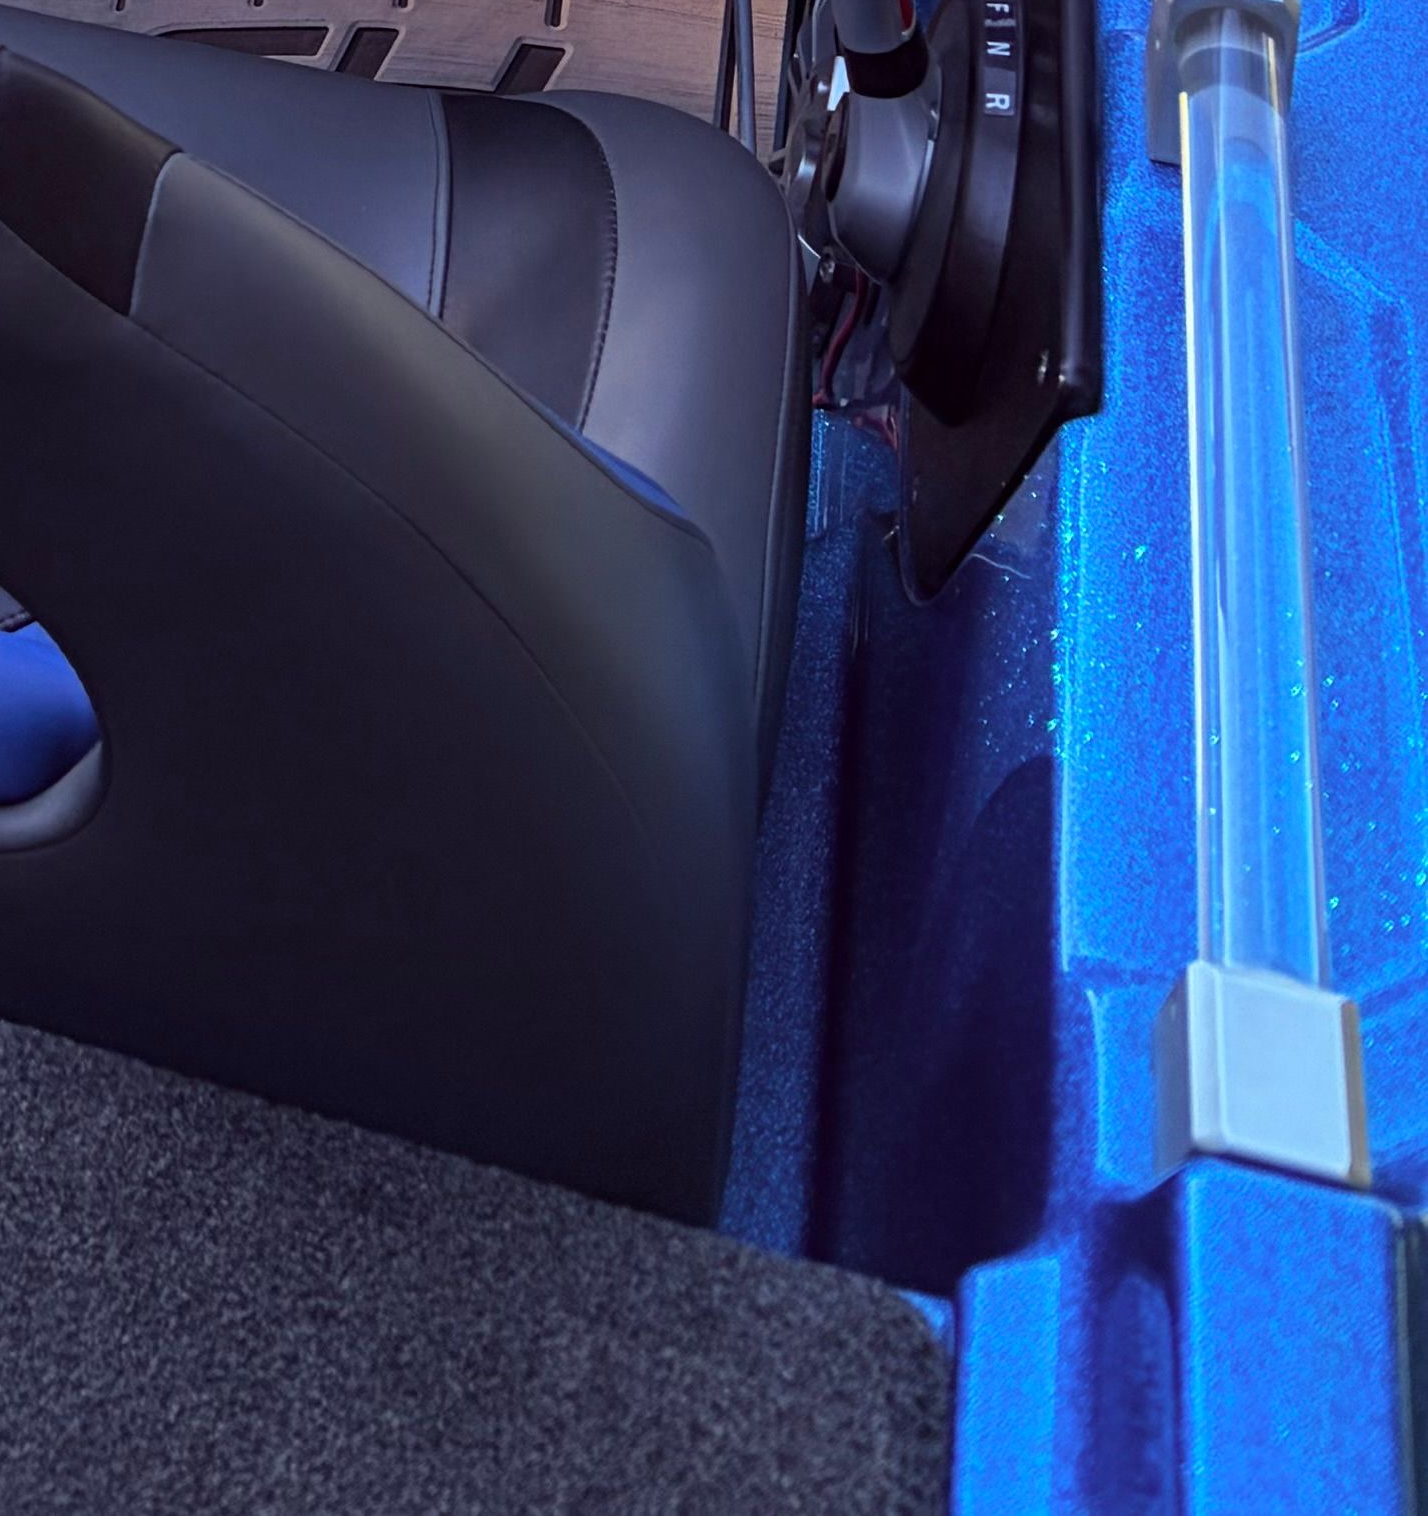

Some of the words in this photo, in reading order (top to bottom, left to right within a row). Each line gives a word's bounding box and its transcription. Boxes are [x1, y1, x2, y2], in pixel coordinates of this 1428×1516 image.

[986, 2, 1010, 13] F
[986, 41, 1011, 56] N
[985, 92, 1011, 110] R
